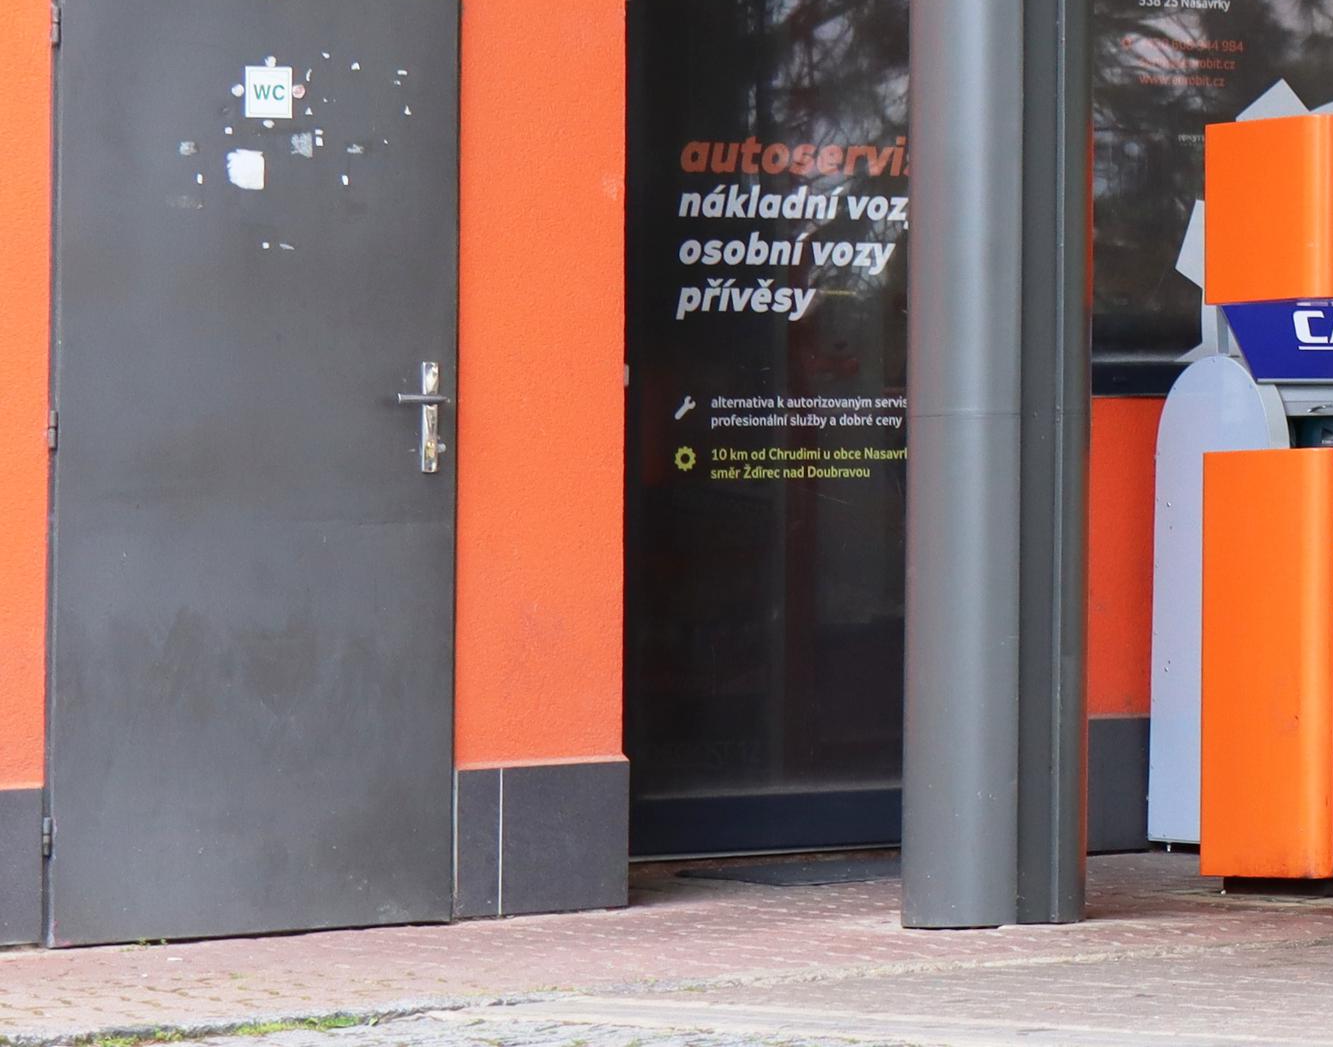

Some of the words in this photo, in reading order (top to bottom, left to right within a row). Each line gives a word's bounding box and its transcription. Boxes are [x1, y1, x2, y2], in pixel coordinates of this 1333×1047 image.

[253, 84, 286, 101] WC
[680, 135, 910, 177] autoservi
[678, 183, 845, 220] nákladní
[847, 195, 909, 230] voz
[679, 231, 809, 266] osobní
[811, 241, 896, 275] vozy
[676, 278, 817, 321] přívěsy
[711, 396, 775, 409] alternativa
[777, 395, 784, 408] k
[786, 395, 873, 411] autorizovaným
[711, 413, 788, 429] profesionální
[790, 413, 827, 429] služby
[829, 416, 837, 426] a
[839, 413, 873, 427] dobré
[875, 416, 903, 429] ceny
[711, 448, 727, 461] 10
[730, 448, 748, 461] km
[751, 448, 766, 461] od
[768, 447, 821, 460] Chrudimi
[823, 450, 831, 460] u
[833, 448, 861, 460] obce
[864, 447, 908, 460] Nasavr
[710, 466, 741, 479] směr
[743, 463, 780, 479] Ždírec
[783, 466, 804, 478] nad
[807, 465, 870, 478] Doubravou
